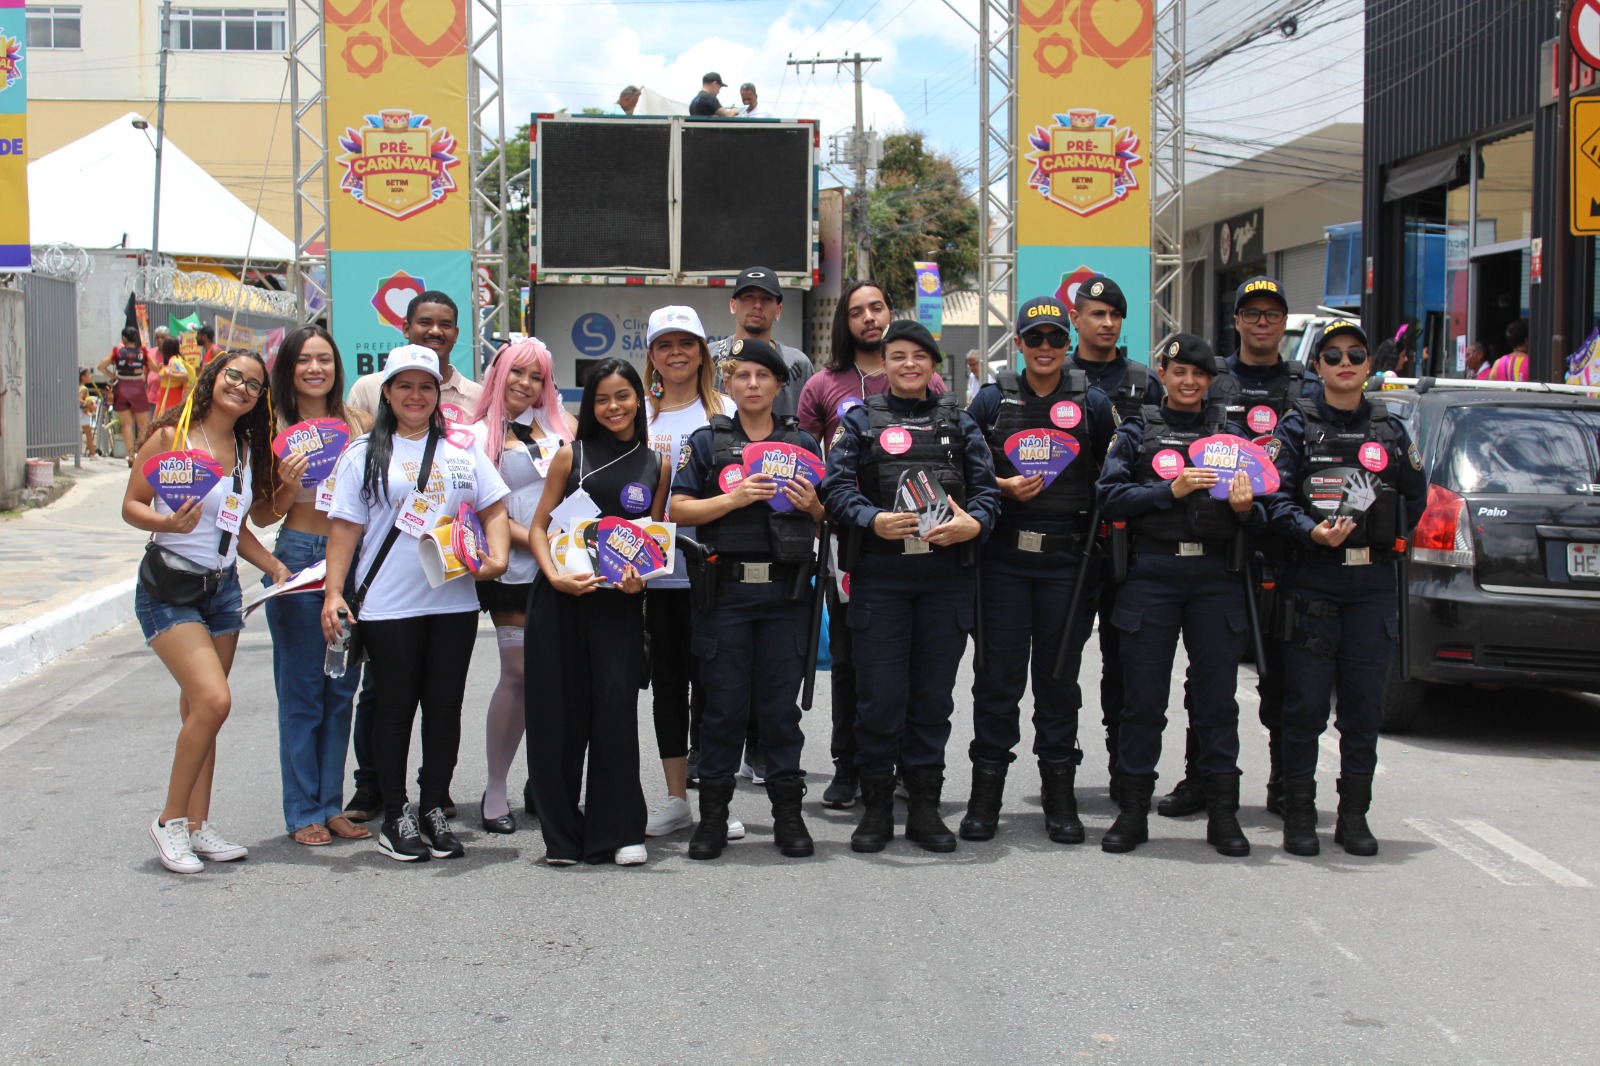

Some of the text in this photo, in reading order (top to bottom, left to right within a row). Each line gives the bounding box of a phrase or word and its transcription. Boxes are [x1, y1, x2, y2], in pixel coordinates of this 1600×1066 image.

[380, 140, 413, 153] PRÉ-
[1067, 139, 1098, 151] PRÉ-
[354, 156, 440, 174] CARNAVAL
[1042, 154, 1122, 172] CARNAVAL
[1244, 280, 1278, 293] GMB
[1027, 304, 1061, 318] GMB
[622, 319, 648, 330] Clín
[287, 427, 318, 447] NÃO É
[1020, 436, 1050, 448] NÃO É
[290, 438, 323, 454] NÃO!
[654, 442, 672, 452] PRA
[1020, 446, 1050, 459] NÃO!
[1206, 443, 1238, 456] NÃO É
[160, 457, 192, 471] NÃO É
[764, 450, 795, 464] NÃO É
[1204, 453, 1236, 468] NÃO!
[160, 468, 192, 483] NÃO!
[762, 462, 795, 477] NÃO!
[424, 481, 446, 493] ALAR
[458, 482, 474, 490] CRIME
[406, 514, 423, 525] APOIO
[614, 525, 644, 550] NÃO É
[608, 534, 636, 559] NÃO!
[1574, 554, 1596, 574] HE
